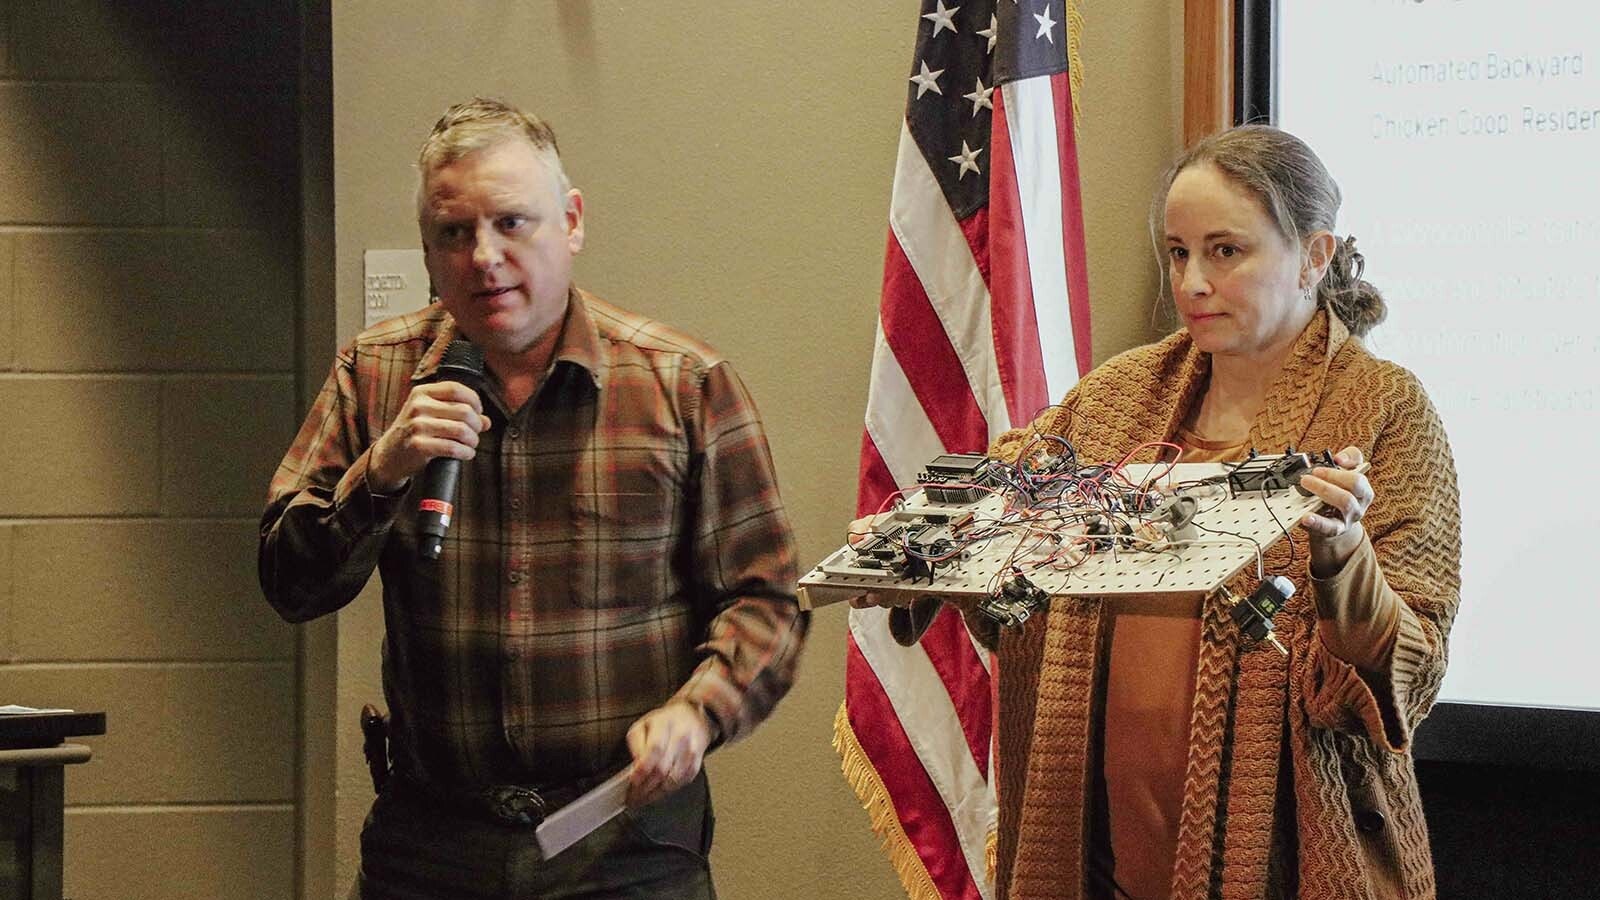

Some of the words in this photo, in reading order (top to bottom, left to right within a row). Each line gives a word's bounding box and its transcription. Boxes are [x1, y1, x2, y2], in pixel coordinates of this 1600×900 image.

[1371, 60, 1480, 84] Automated
[1487, 52, 1583, 84] Backyard
[1372, 112, 1449, 138] Chicken
